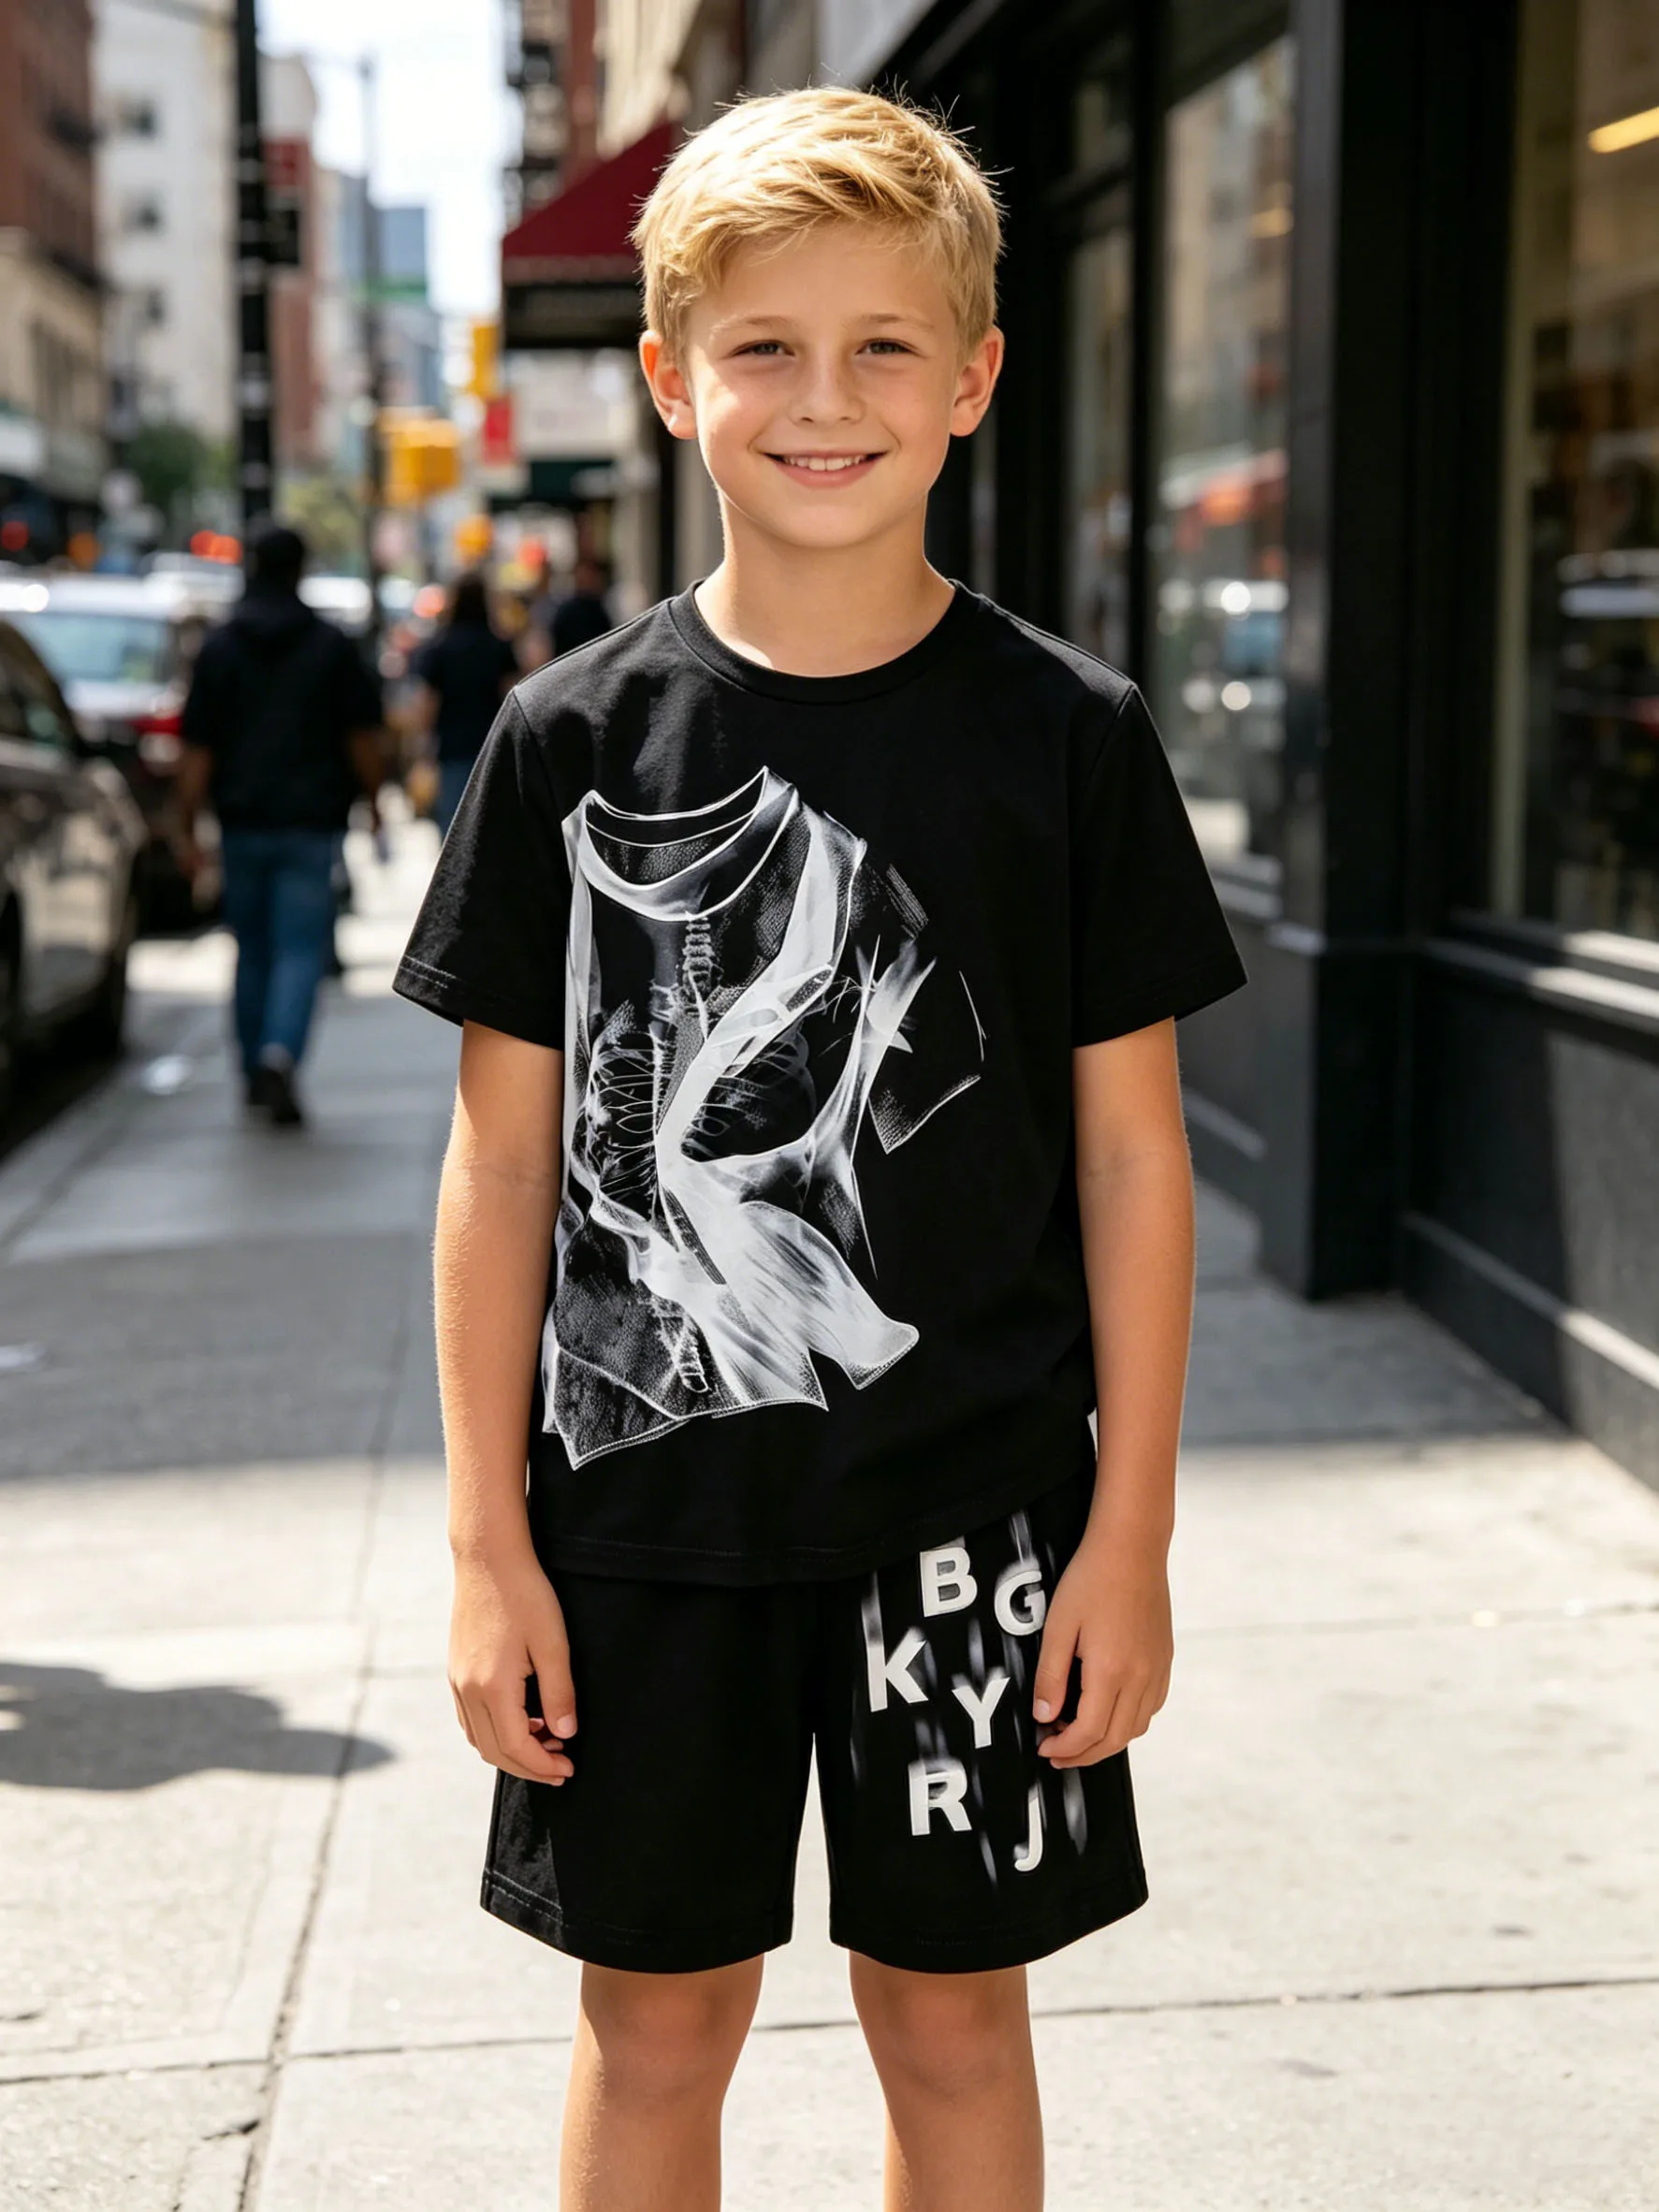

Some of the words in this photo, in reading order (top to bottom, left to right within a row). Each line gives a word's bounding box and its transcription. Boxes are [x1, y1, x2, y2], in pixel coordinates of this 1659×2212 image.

[920, 1546, 978, 1617] B
[994, 1565, 1047, 1636] G
[866, 1629, 929, 1712] K
[952, 1674, 1011, 1749] Y
[907, 1757, 972, 1837] R
[1013, 1783, 1044, 1871] J
